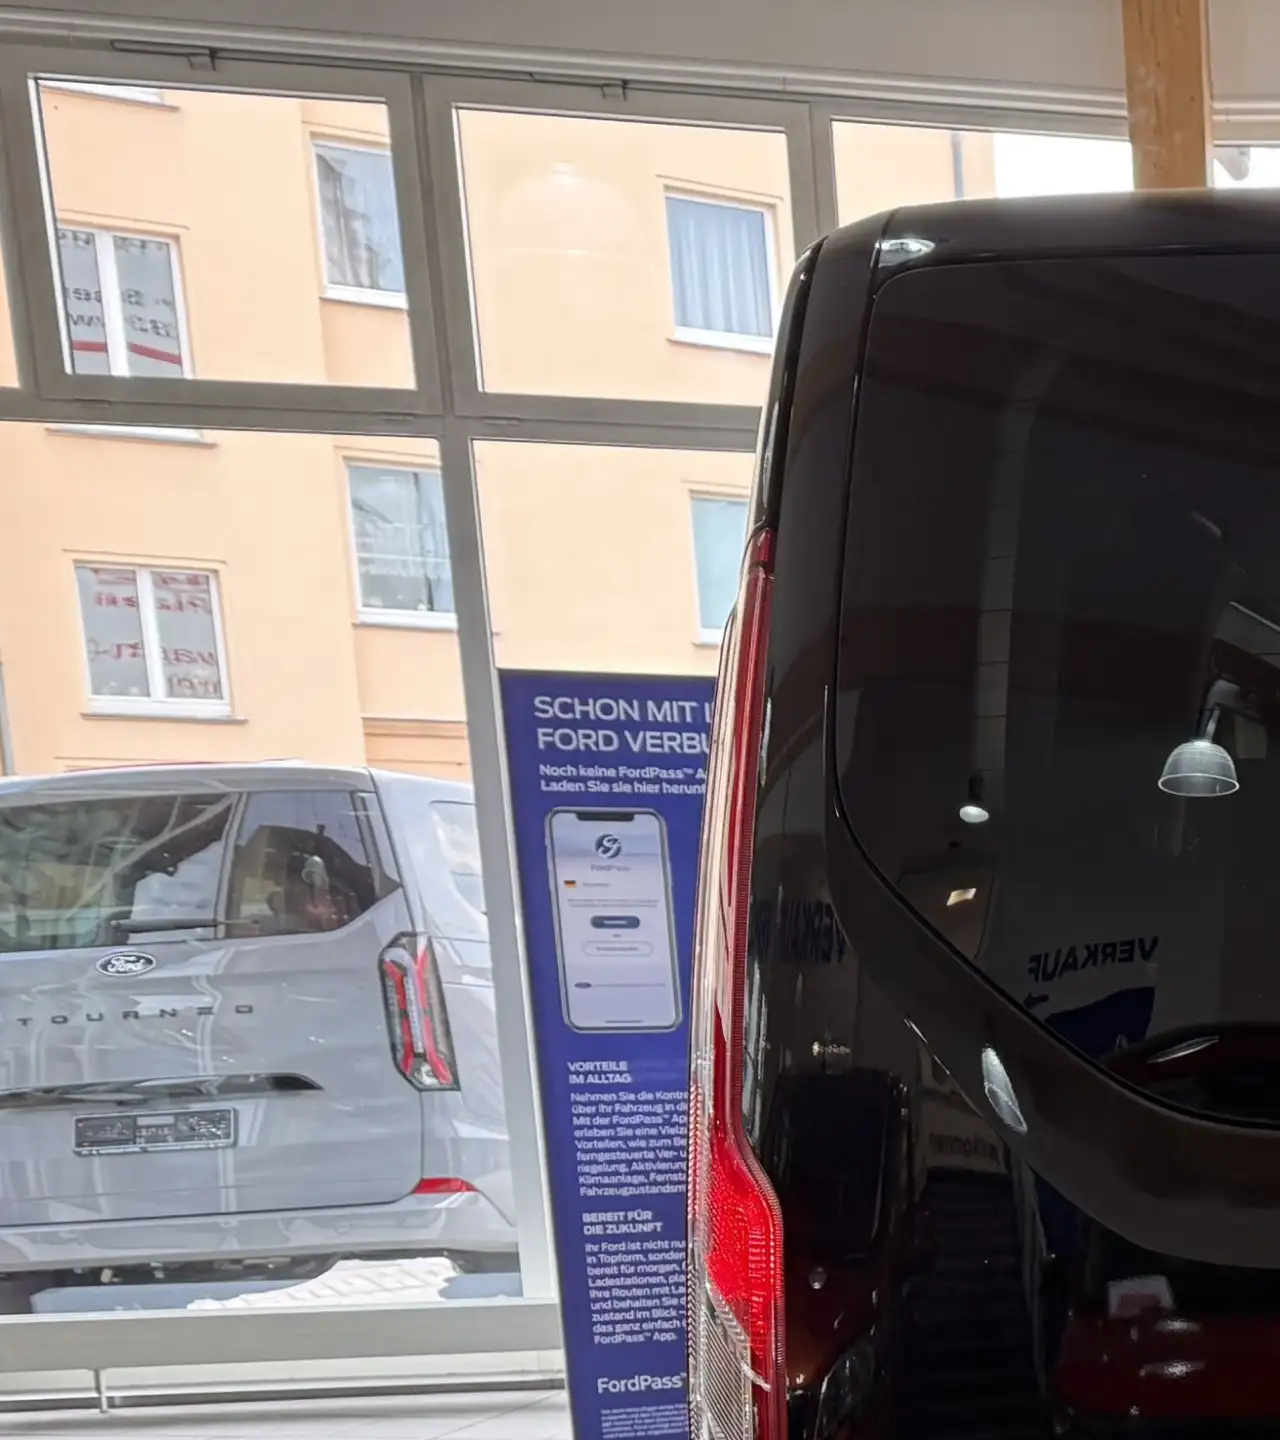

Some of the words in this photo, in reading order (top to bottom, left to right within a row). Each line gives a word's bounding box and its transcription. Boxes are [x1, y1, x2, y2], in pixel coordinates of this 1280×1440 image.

[534, 697, 640, 720] SCHON
[647, 701, 699, 722] MIT
[537, 728, 619, 751] FORD
[539, 765, 577, 776] Noch
[579, 765, 616, 777] keine
[541, 780, 584, 791] Laden
[588, 781, 609, 792] Sie
[612, 781, 631, 793] sie
[634, 782, 660, 793] hier
[18, 1005, 253, 1027] TOURNEO
[567, 1061, 628, 1071] VORTEILE
[569, 1075, 584, 1084] IM
[587, 1073, 632, 1083] ALLTAG
[571, 1093, 616, 1102] Nehmen
[619, 1092, 635, 1100] Sie
[637, 1092, 653, 1100] die
[571, 1104, 596, 1114] über
[615, 1103, 663, 1113] Fahrzeug
[573, 1116, 591, 1125] Mit
[593, 1116, 609, 1125] der
[574, 1128, 614, 1137] erleben
[616, 1127, 633, 1136] Sie
[635, 1127, 657, 1135] eine
[582, 1211, 625, 1222] BEREIT
[627, 1209, 652, 1221] FÜR
[584, 1225, 604, 1235] DIE
[606, 1222, 663, 1233] ZUKUNFT
[602, 1242, 625, 1251] Ford
[643, 1240, 669, 1249] nicht
[587, 1266, 618, 1275] bereit
[620, 1264, 634, 1273] für
[612, 1288, 649, 1297] Routen
[591, 1301, 611, 1310] und
[613, 1298, 659, 1308] behalten
[662, 1297, 678, 1305] Sie
[592, 1311, 634, 1321] zustand
[652, 1308, 676, 1317] Blick
[593, 1324, 613, 1332] das
[615, 1324, 640, 1332] ganz
[642, 1320, 680, 1329] einfach
